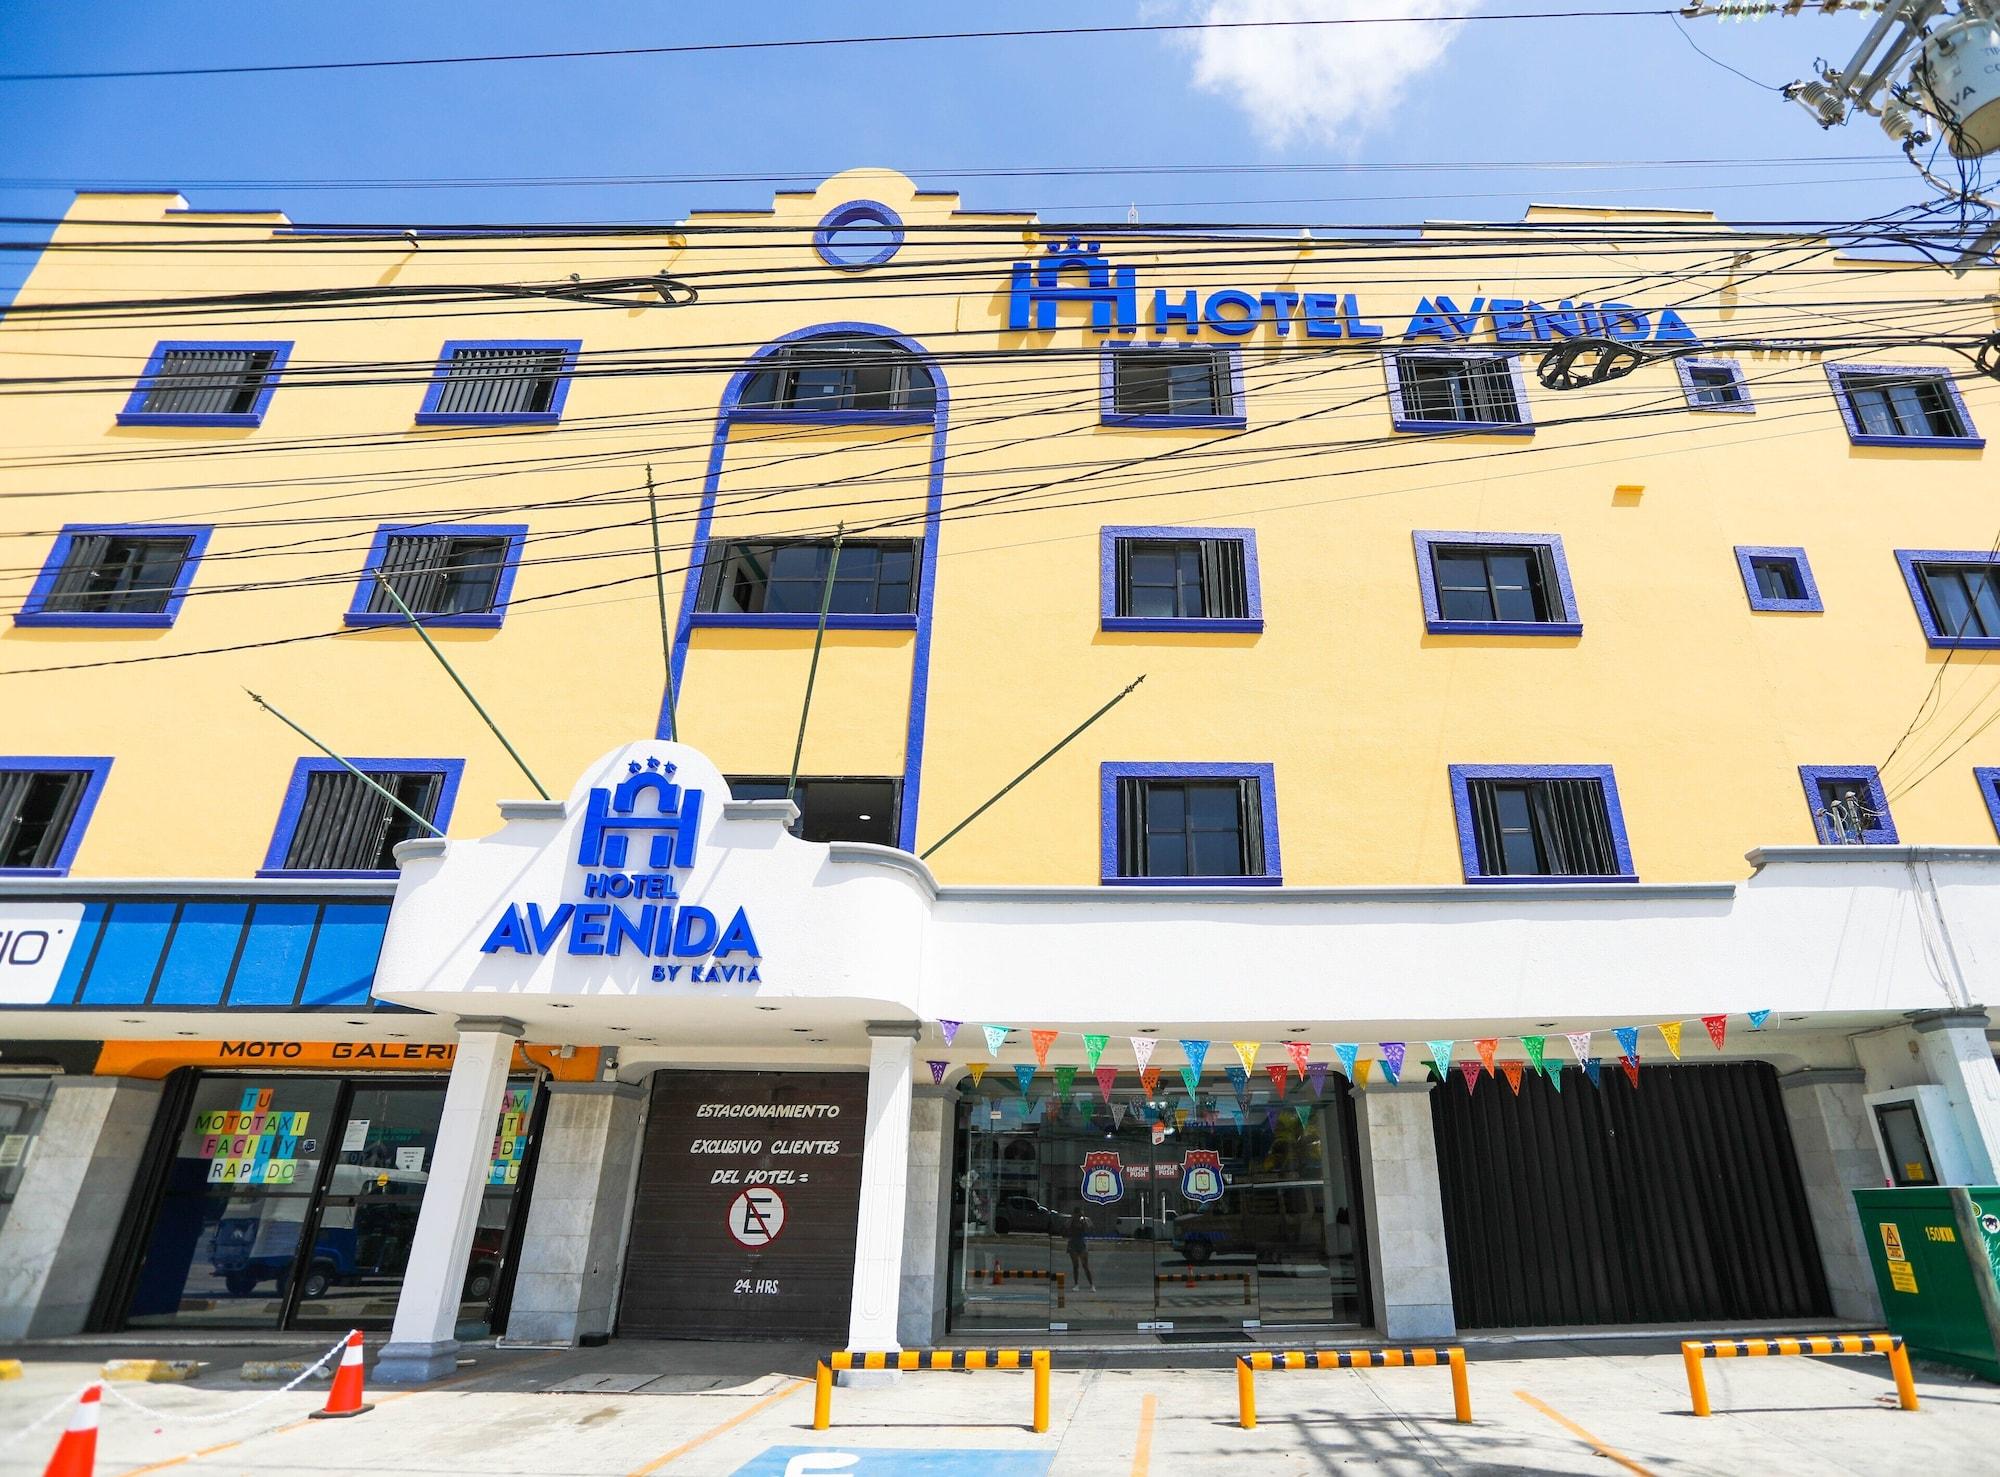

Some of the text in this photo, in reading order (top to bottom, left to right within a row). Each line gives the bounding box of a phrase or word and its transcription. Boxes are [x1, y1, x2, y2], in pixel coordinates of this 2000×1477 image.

[1154, 289, 1703, 346] HOTEL AVENIDA
[584, 872, 680, 900] HOTEL
[480, 901, 763, 959] AVENIDA
[651, 963, 763, 984] BY KAVIA
[219, 1040, 455, 1060] MOTO GALERI
[247, 1093, 272, 1108] TU
[696, 1103, 841, 1119] ESTACIONAMIENTO
[194, 1115, 302, 1130] MOTOTAXI
[205, 1139, 270, 1154] FACIL
[283, 1139, 295, 1155] Y
[690, 1139, 841, 1155] EXCLUSIVO CLIENTES
[211, 1163, 295, 1179] RAPIDO
[710, 1169, 740, 1184] DEL
